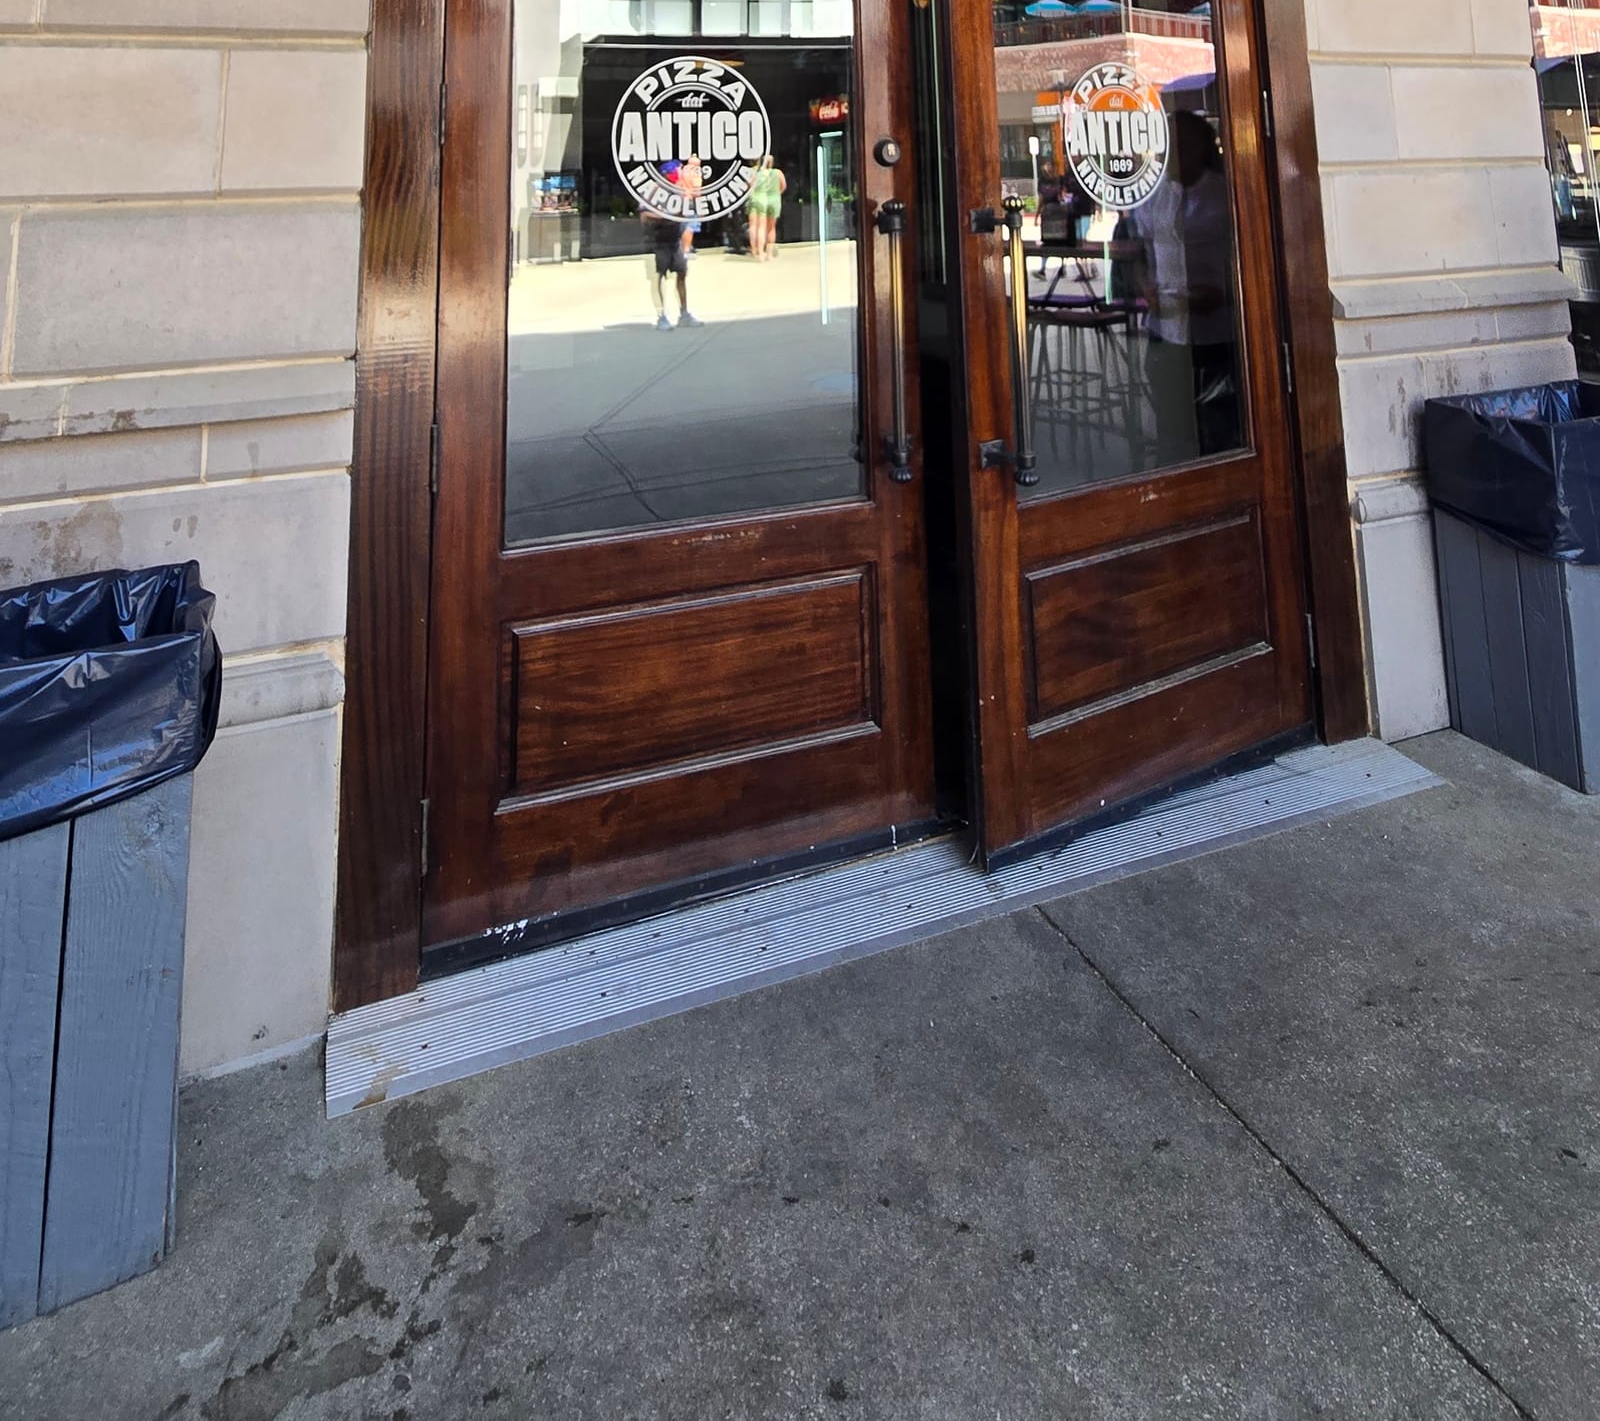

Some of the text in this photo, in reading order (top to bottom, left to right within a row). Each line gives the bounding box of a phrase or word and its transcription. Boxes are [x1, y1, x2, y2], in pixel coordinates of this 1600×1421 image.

[634, 61, 746, 107] PIZZA
[1109, 94, 1124, 108] dal
[618, 111, 764, 162] ANTICO
[1070, 111, 1165, 156] ANTICO
[626, 165, 755, 216] NAPOLETANA
[1077, 159, 1162, 204] NAPOLETANA
